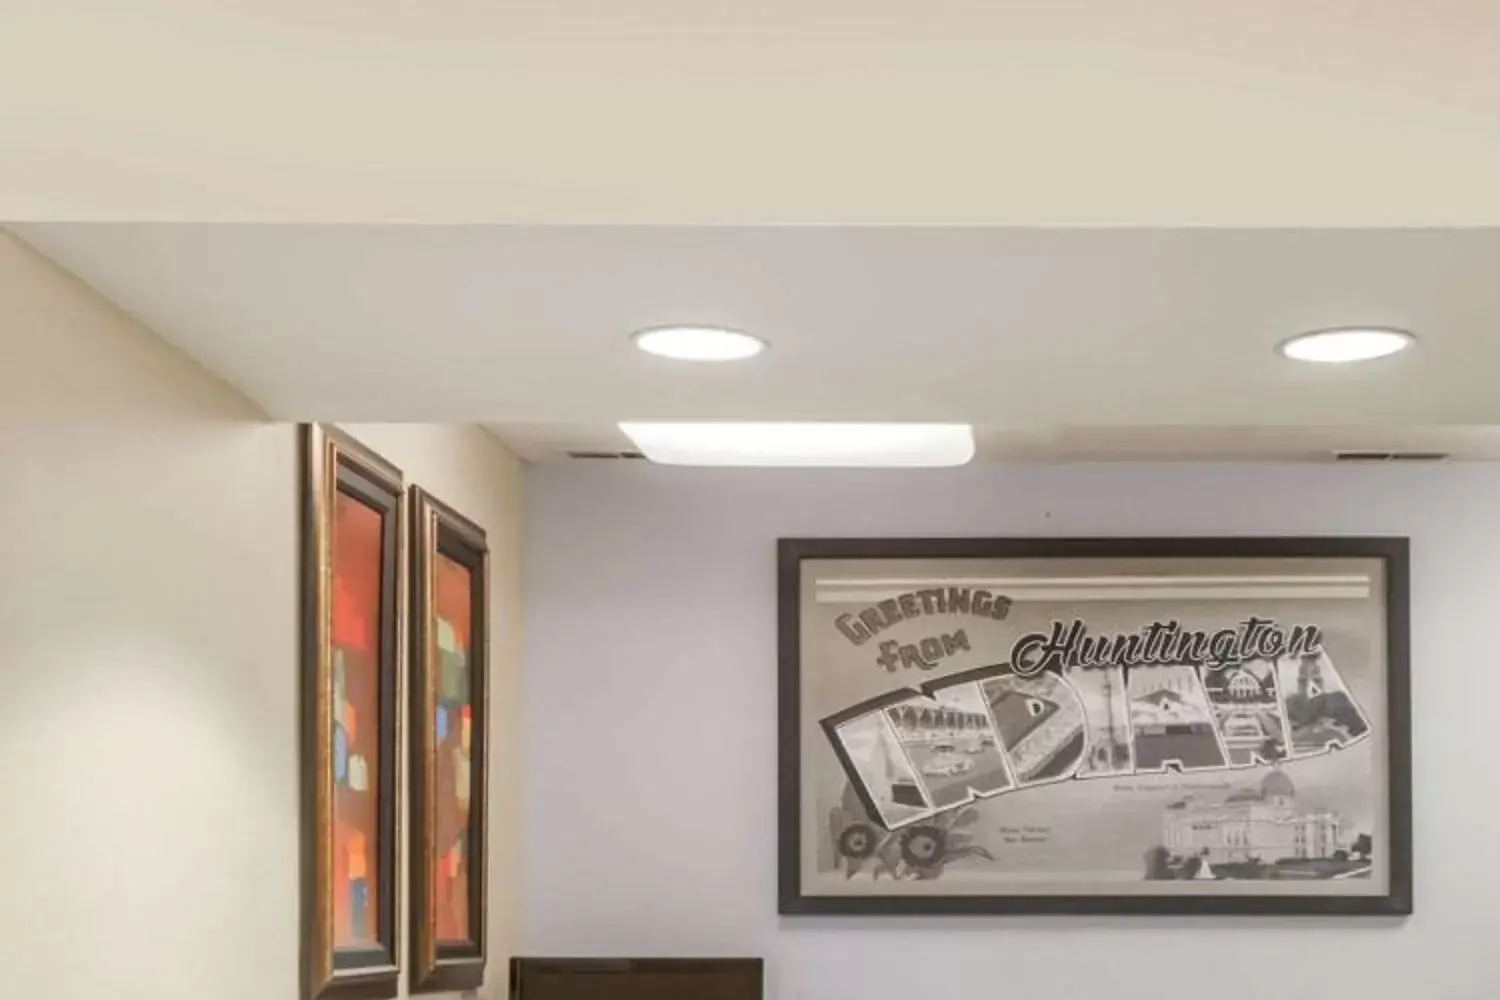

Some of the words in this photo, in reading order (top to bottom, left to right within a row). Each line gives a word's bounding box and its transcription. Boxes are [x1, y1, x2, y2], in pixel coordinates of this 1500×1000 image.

[834, 587, 1013, 646] GREETINGS
[1010, 617, 1323, 676] Huntington
[818, 645, 1373, 831] INDIANA
